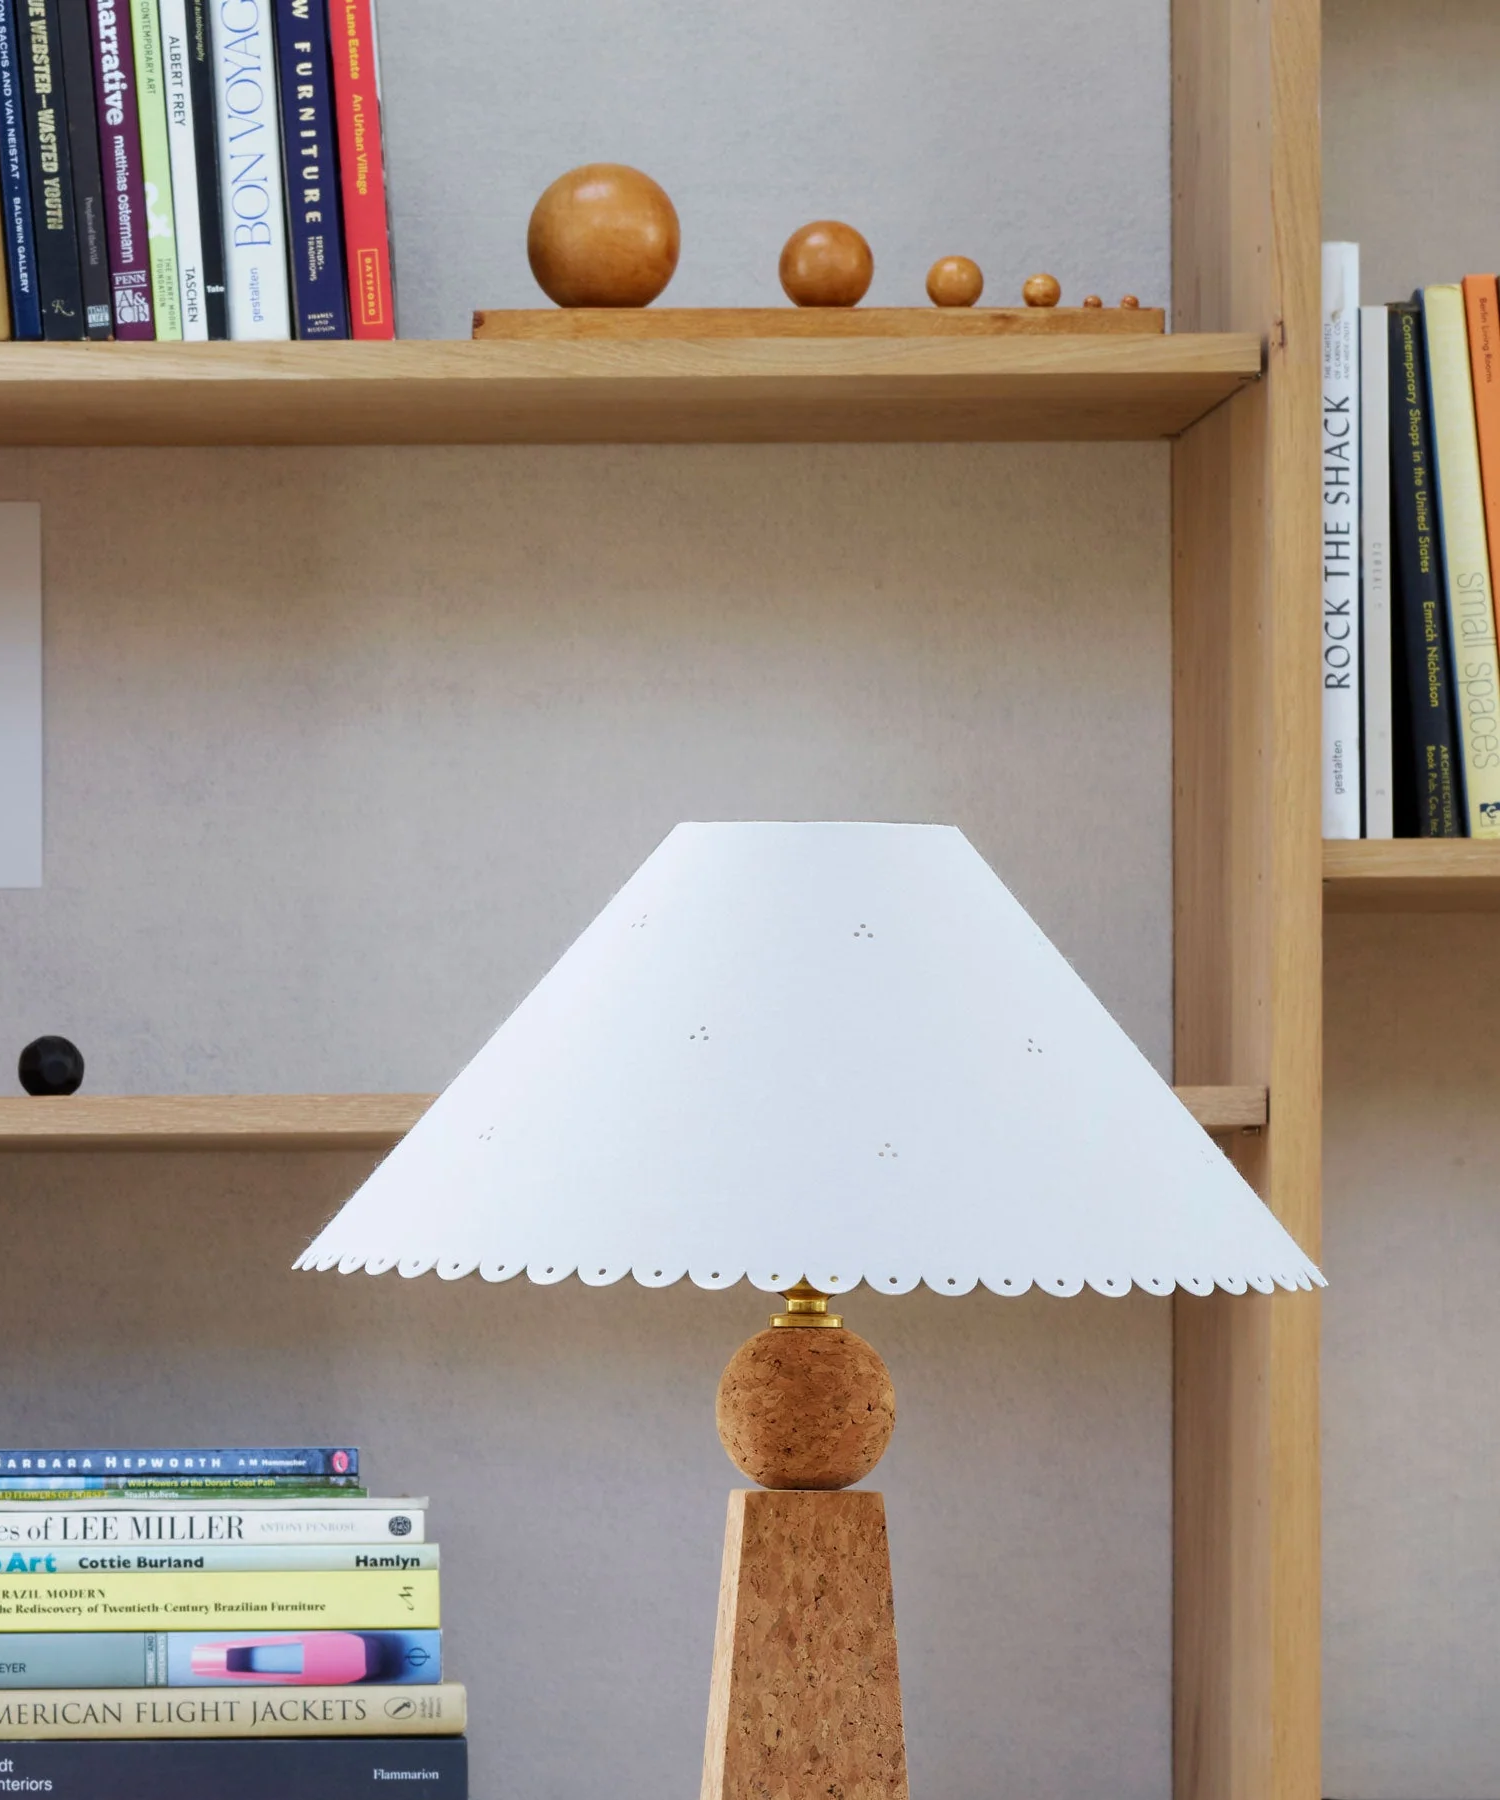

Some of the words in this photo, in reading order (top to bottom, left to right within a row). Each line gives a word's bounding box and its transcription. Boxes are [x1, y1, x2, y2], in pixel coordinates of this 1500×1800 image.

[141, 1, 154, 73] CONTEMPORARY
[346, 5, 357, 37] Lane
[169, 36, 183, 88] ALBERT
[220, 0, 265, 142] VOYAG
[348, 38, 360, 80] Estate
[2, 71, 12, 96] AND
[147, 77, 156, 94] ART
[352, 93, 363, 112] An
[5, 100, 15, 124] VAN
[173, 93, 186, 127] FREY
[294, 42, 322, 223] FURNITURE
[354, 113, 365, 151] Urban
[7, 128, 20, 180] NEISTAT
[113, 135, 130, 192] matthias
[356, 153, 368, 195] Village
[44, 177, 64, 231] YOUTH
[231, 152, 272, 248] BON
[13, 197, 24, 244] BALDWIN
[117, 195, 133, 263] ostermann
[17, 245, 29, 293] GALLERY
[115, 273, 146, 285] PENN
[364, 257, 376, 316] BATSFORD
[185, 266, 198, 323] TASCHEN
[250, 267, 264, 322] gestalten
[1479, 297, 1488, 324] Berlin
[1482, 326, 1490, 352] Living
[1402, 315, 1417, 404] Contemporary
[1484, 353, 1493, 384] Rooms
[1408, 408, 1422, 447] Shops
[1324, 396, 1350, 505] SHACK
[1412, 451, 1424, 462] in
[1413, 467, 1425, 486] the
[1415, 491, 1429, 531] United
[1324, 522, 1350, 582] THE
[1419, 536, 1430, 574] States
[1423, 601, 1438, 642] Emrich
[1457, 572, 1497, 649] small
[1324, 599, 1350, 689] ROCK
[1427, 646, 1441, 708] Nicholson
[1458, 662, 1499, 770] spaces
[1332, 740, 1345, 795] gestalten
[1426, 745, 1436, 770] Book
[1440, 745, 1452, 834] ARCHITECTURAL
[106, 1456, 221, 1469] HEPWORTH
[238, 1459, 245, 1467] A
[12, 1490, 56, 1499] FLOWERS
[124, 1490, 148, 1499] Stuart
[149, 1490, 179, 1499] Roberts
[128, 1478, 148, 1487] Wild
[149, 1478, 178, 1488] Flowers
[180, 1478, 189, 1487] of
[190, 1478, 202, 1487] the
[205, 1478, 231, 1487] Dorset
[233, 1478, 255, 1487] Coast
[257, 1478, 276, 1487] Path
[27, 1515, 53, 1541] of
[61, 1516, 119, 1541] LEE
[129, 1515, 244, 1541] MILLER
[259, 1523, 303, 1533] ANTONY
[305, 1522, 356, 1533] PENROSE
[6, 1553, 57, 1573] Art
[78, 1555, 131, 1569] Cottie
[137, 1555, 204, 1569] Burland
[355, 1555, 421, 1570] Hamlyn
[15, 1603, 83, 1616] Rediscovery
[87, 1603, 99, 1614] of
[102, 1602, 210, 1615] Twentieth-Century
[214, 1602, 268, 1613] Brazilian
[270, 1602, 326, 1612] Furniture
[47, 1589, 106, 1599] MODERN
[136, 1701, 241, 1724] FLIGHT
[250, 1700, 367, 1726] JACKETS
[373, 1769, 439, 1780] Flammarion
